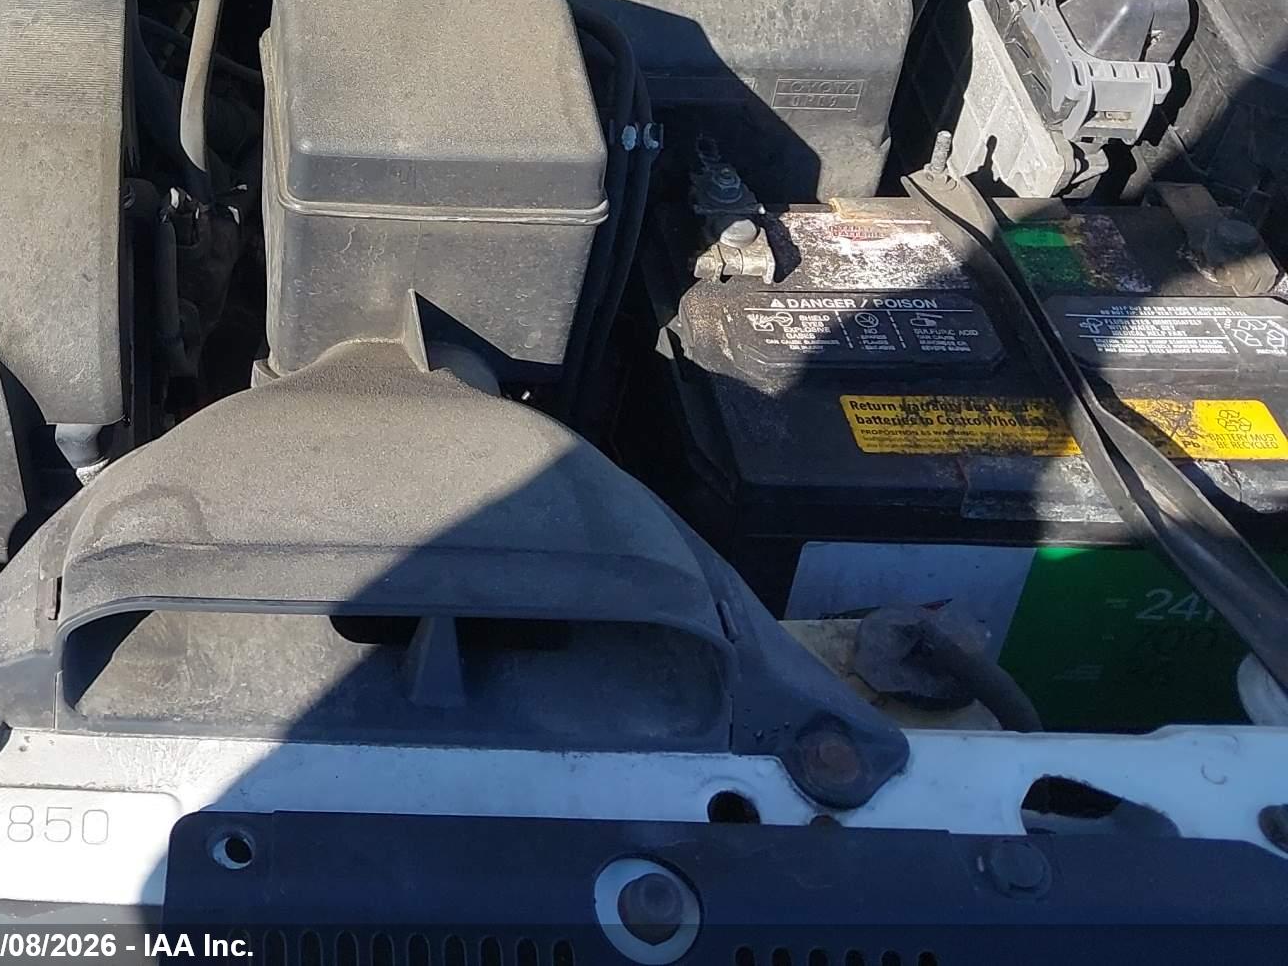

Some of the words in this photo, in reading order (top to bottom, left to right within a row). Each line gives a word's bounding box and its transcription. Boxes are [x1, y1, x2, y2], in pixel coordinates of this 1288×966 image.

[786, 298, 856, 308] DANGER
[873, 298, 937, 308] POISON
[849, 400, 897, 412] Return
[937, 415, 982, 426] Costco
[1209, 433, 1249, 442] BATTERY
[1250, 434, 1278, 442] MUST
[1182, 440, 1201, 449] Pb
[1233, 442, 1279, 450] RECYCLED
